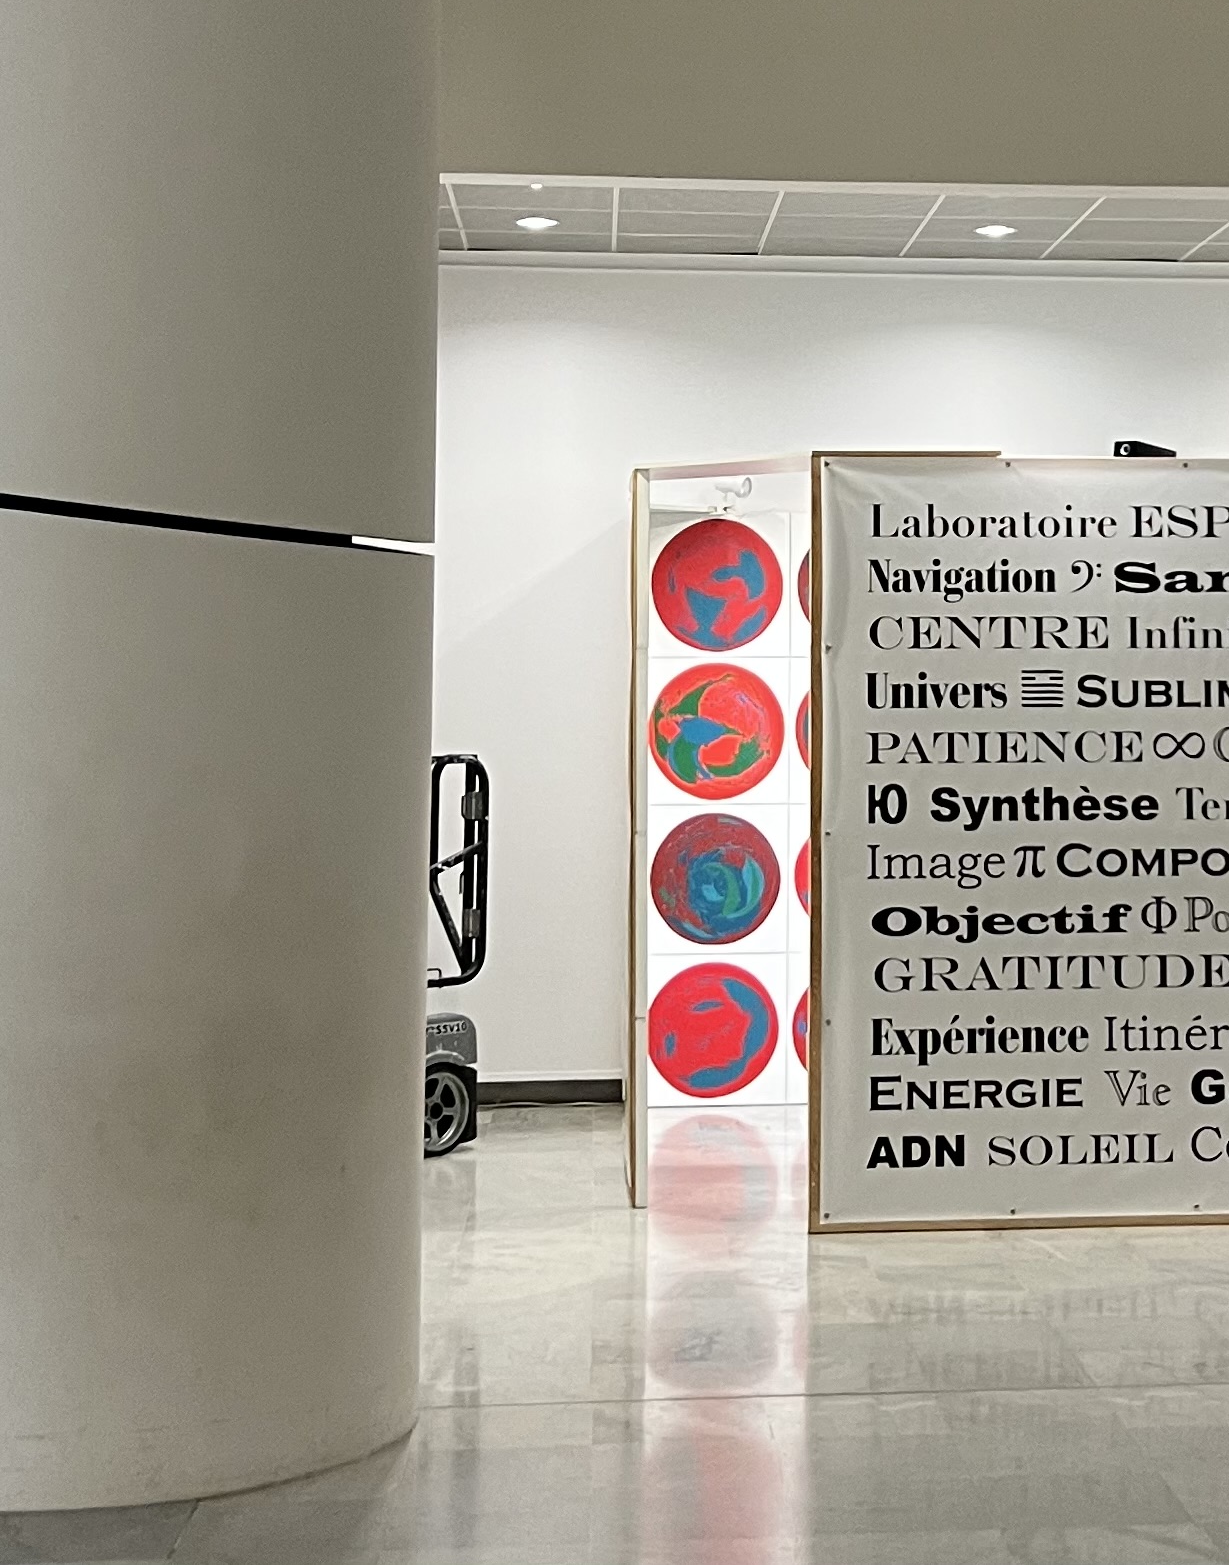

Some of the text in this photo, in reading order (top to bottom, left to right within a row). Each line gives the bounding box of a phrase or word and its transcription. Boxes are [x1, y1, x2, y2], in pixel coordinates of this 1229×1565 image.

[871, 503, 1117, 539] Laboratoire
[867, 558, 1057, 604] Navigation
[869, 615, 1109, 651] CENTRE
[865, 671, 1008, 710] Univers
[865, 730, 1144, 765] PATIENCE
[930, 785, 1160, 832] Synthèse
[866, 844, 1006, 890] Image
[871, 903, 1133, 942] Objectif
[871, 1014, 1089, 1061] Expérience
[869, 1074, 1084, 1112] ENERGIE
[1103, 1069, 1172, 1107] Vie
[866, 1134, 965, 1170] ADN
[988, 1133, 1174, 1167] SOLEIL
